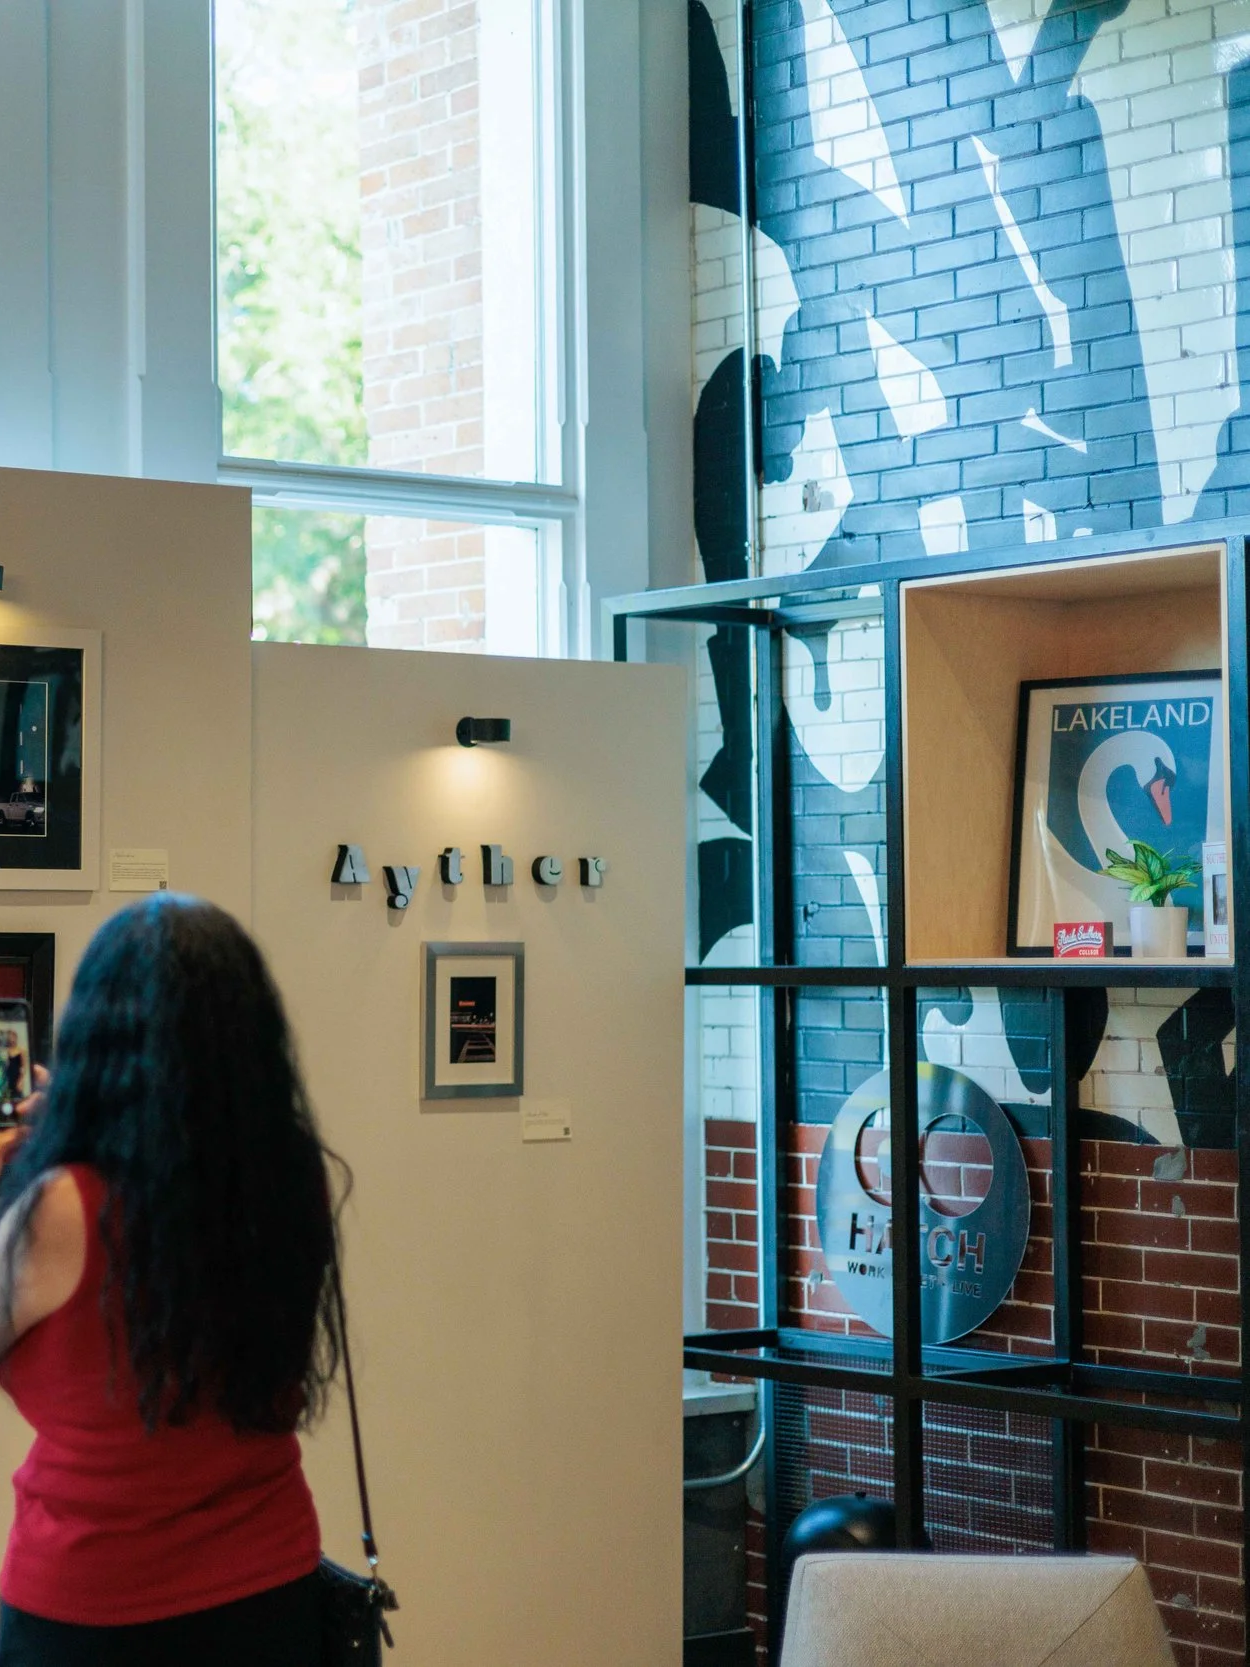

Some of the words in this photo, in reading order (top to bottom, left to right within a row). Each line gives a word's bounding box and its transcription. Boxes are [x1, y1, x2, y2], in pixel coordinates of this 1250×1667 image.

[1053, 702, 1211, 732] LAKELAND
[331, 844, 607, 909] Ayther
[847, 1260, 885, 1279] WORK
[952, 1281, 982, 1298] LIVE
